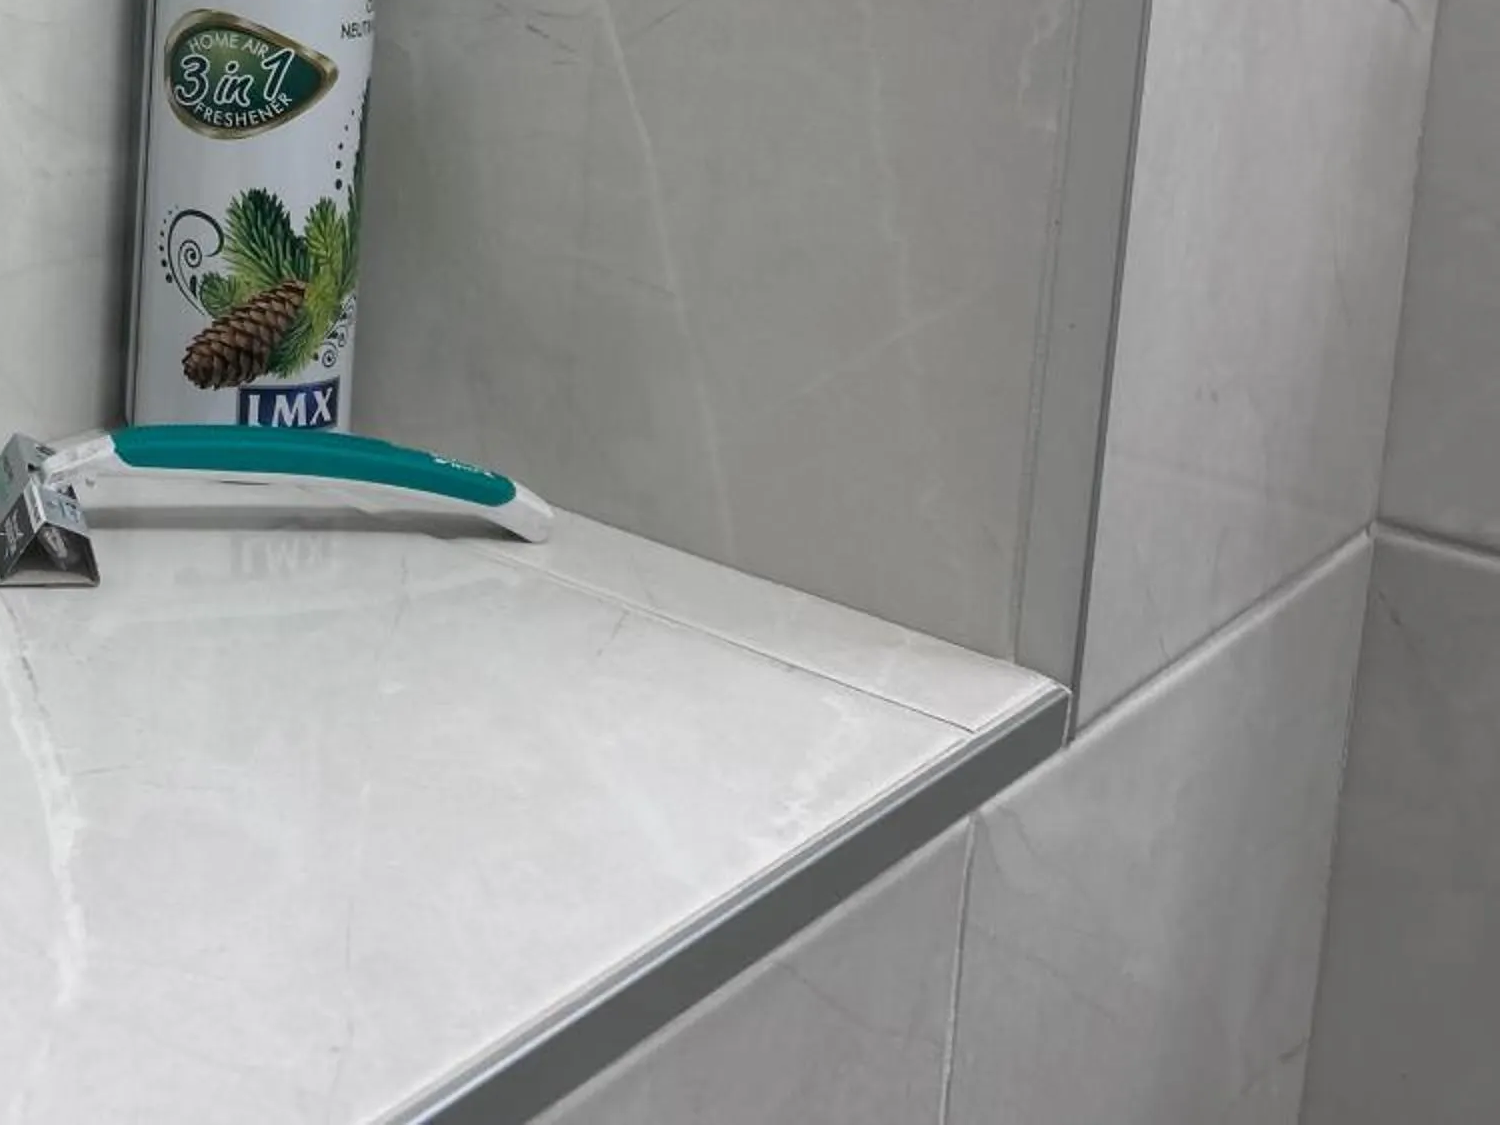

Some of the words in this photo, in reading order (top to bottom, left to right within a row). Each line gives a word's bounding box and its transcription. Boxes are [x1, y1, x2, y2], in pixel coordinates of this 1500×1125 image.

[188, 32, 239, 56] HOME
[241, 38, 269, 60] AIR
[174, 53, 211, 106] 3
[213, 60, 255, 107] in
[261, 47, 295, 101] 1
[193, 92, 293, 128] FRESHENER
